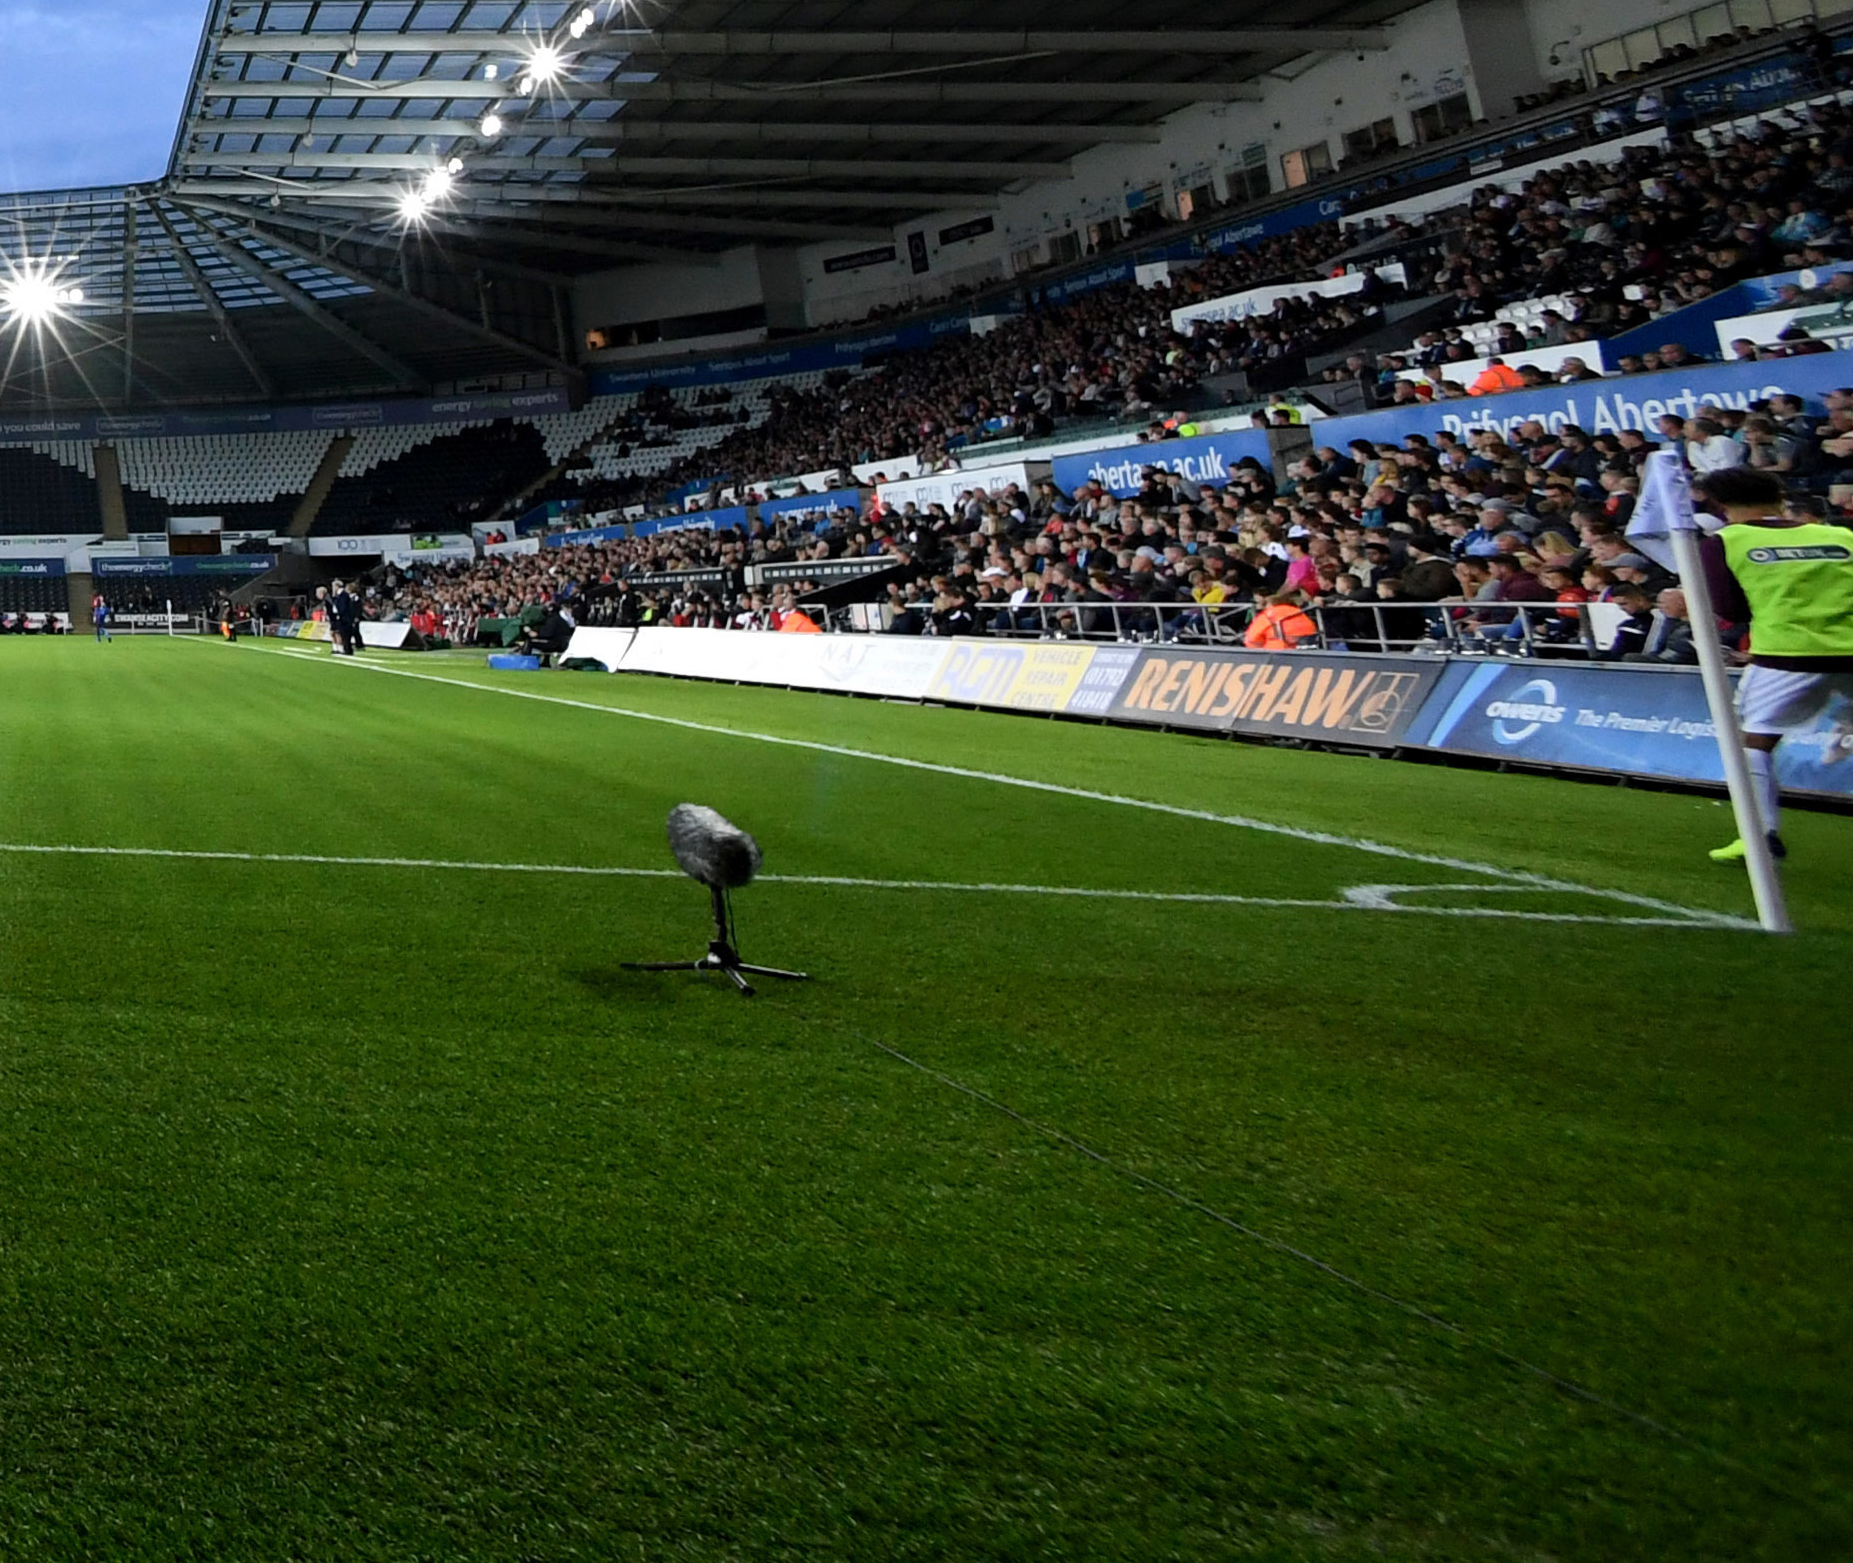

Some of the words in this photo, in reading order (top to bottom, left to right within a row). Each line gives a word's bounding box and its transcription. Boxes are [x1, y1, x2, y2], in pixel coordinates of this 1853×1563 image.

[431, 400, 472, 413] energy
[511, 393, 559, 407] experts
[3, 423, 24, 435] you
[25, 421, 54, 432] could
[56, 422, 81, 432] save
[38, 537, 68, 547] experts
[1032, 648, 1083, 666] VEHICLE
[1025, 668, 1069, 686] REPAIR
[1010, 690, 1060, 709] CENTRE
[1124, 658, 1376, 730] RENISHAW
[1486, 700, 1567, 723] owens
[1575, 709, 1600, 727] The
[1603, 712, 1668, 734] Premier
[1669, 716, 1716, 740] Logis
